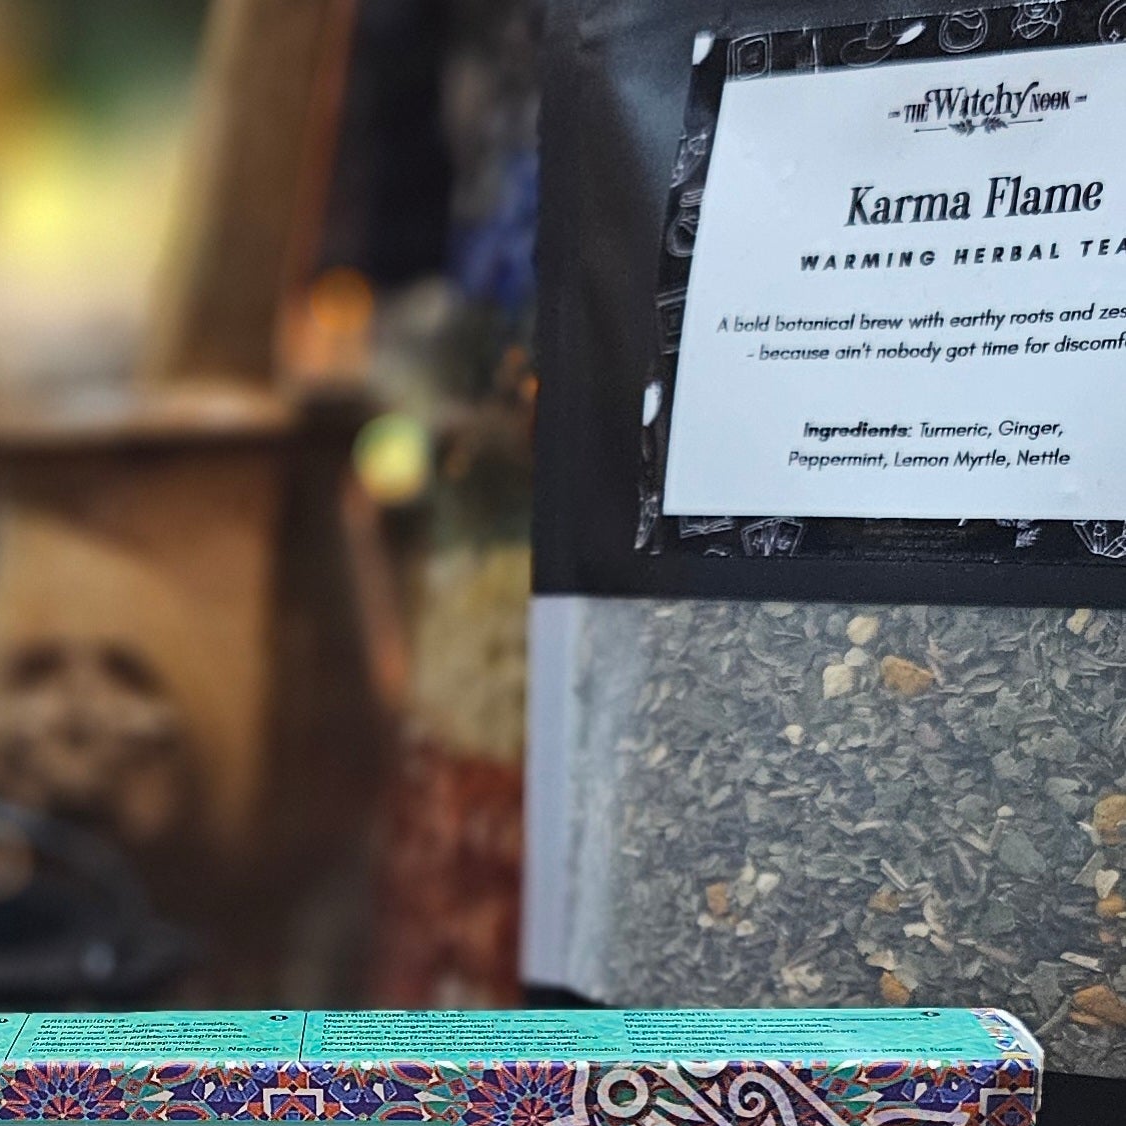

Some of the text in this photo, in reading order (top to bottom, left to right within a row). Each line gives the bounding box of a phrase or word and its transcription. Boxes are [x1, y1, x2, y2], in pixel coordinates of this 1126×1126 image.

[904, 81, 1072, 123] THE Witchy NOOK
[843, 175, 1104, 226] Karma Flame
[800, 249, 936, 271] WARMING
[953, 242, 1060, 266] HERBAL
[716, 316, 728, 333] A
[733, 314, 770, 333] bold
[774, 313, 856, 333] botanical
[859, 313, 903, 331] brew
[908, 311, 944, 330] with
[949, 308, 1005, 332] earthy
[1009, 308, 1055, 325] roots
[1059, 302, 1096, 322] and
[758, 343, 830, 361] because
[835, 341, 872, 360] ain't
[876, 340, 941, 363] nobody
[945, 342, 977, 363] got
[982, 340, 1019, 356] time
[1024, 335, 1051, 354] for
[802, 419, 1064, 442] Ingredients: Turmeric, Ginger,
[788, 447, 1072, 472] Peppermint, Lemon Myrtle, Nettle
